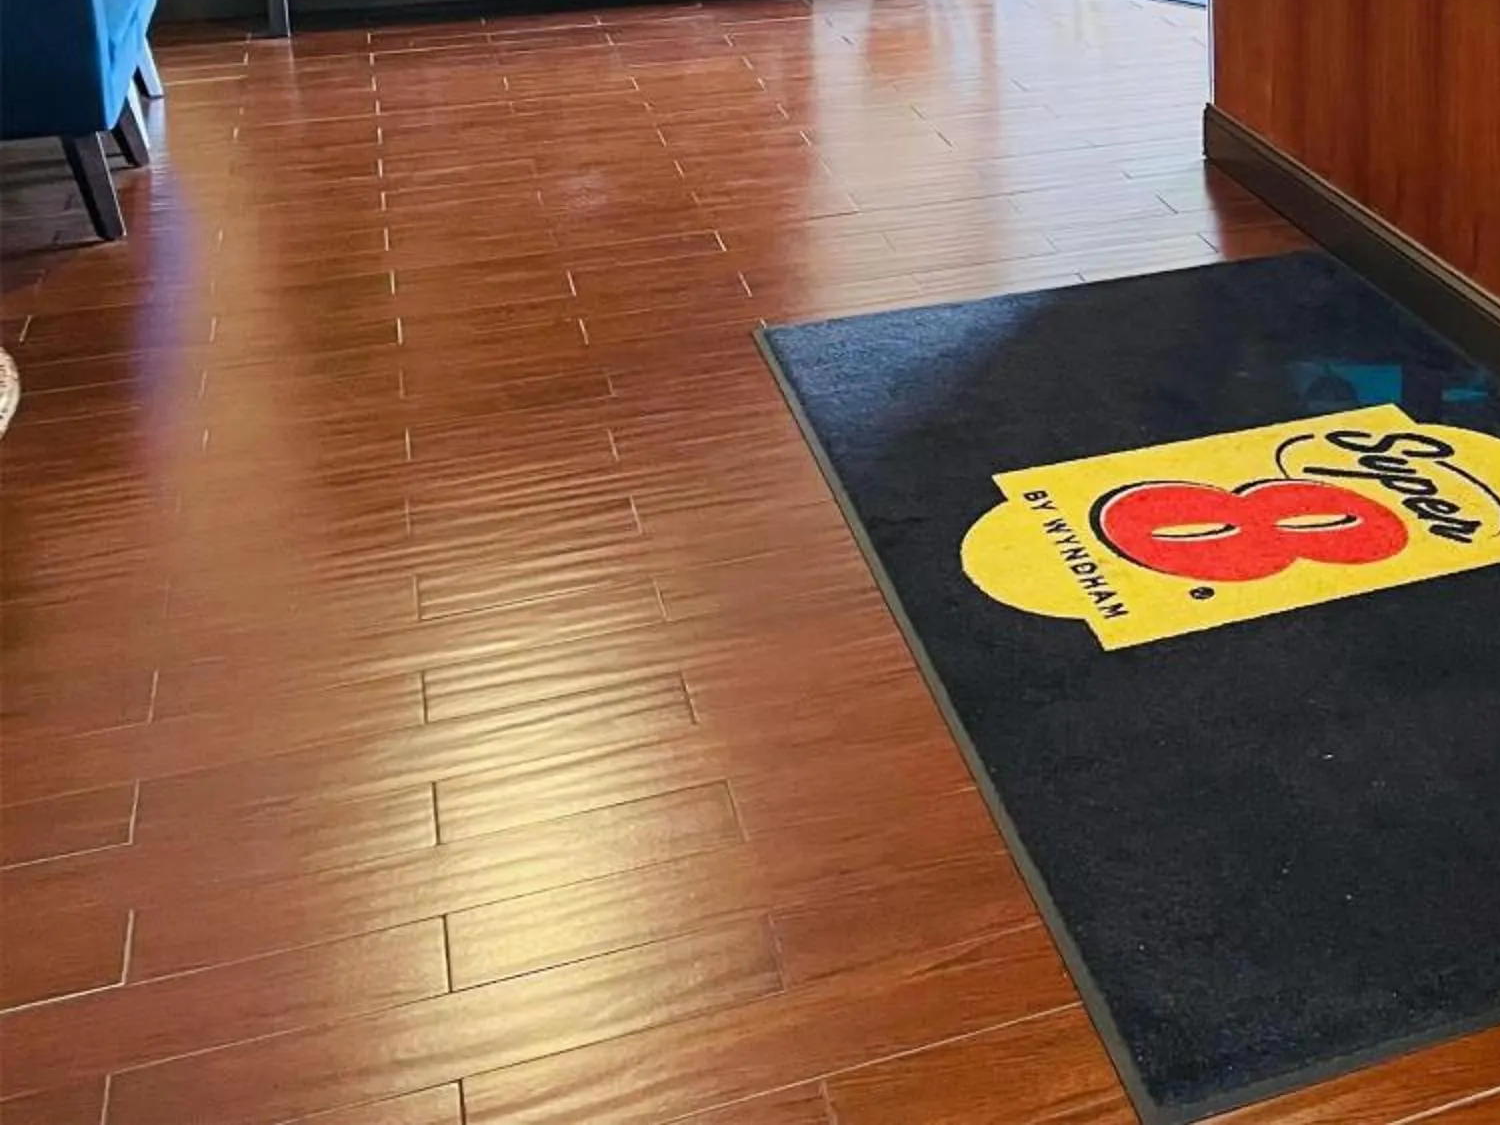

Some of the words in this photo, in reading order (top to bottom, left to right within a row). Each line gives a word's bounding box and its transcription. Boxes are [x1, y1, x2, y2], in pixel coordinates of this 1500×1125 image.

[1089, 478, 1409, 583] 8
[1303, 430, 1482, 543] Super
[1023, 490, 1057, 512] BY
[1043, 517, 1130, 619] WYNDHAM
